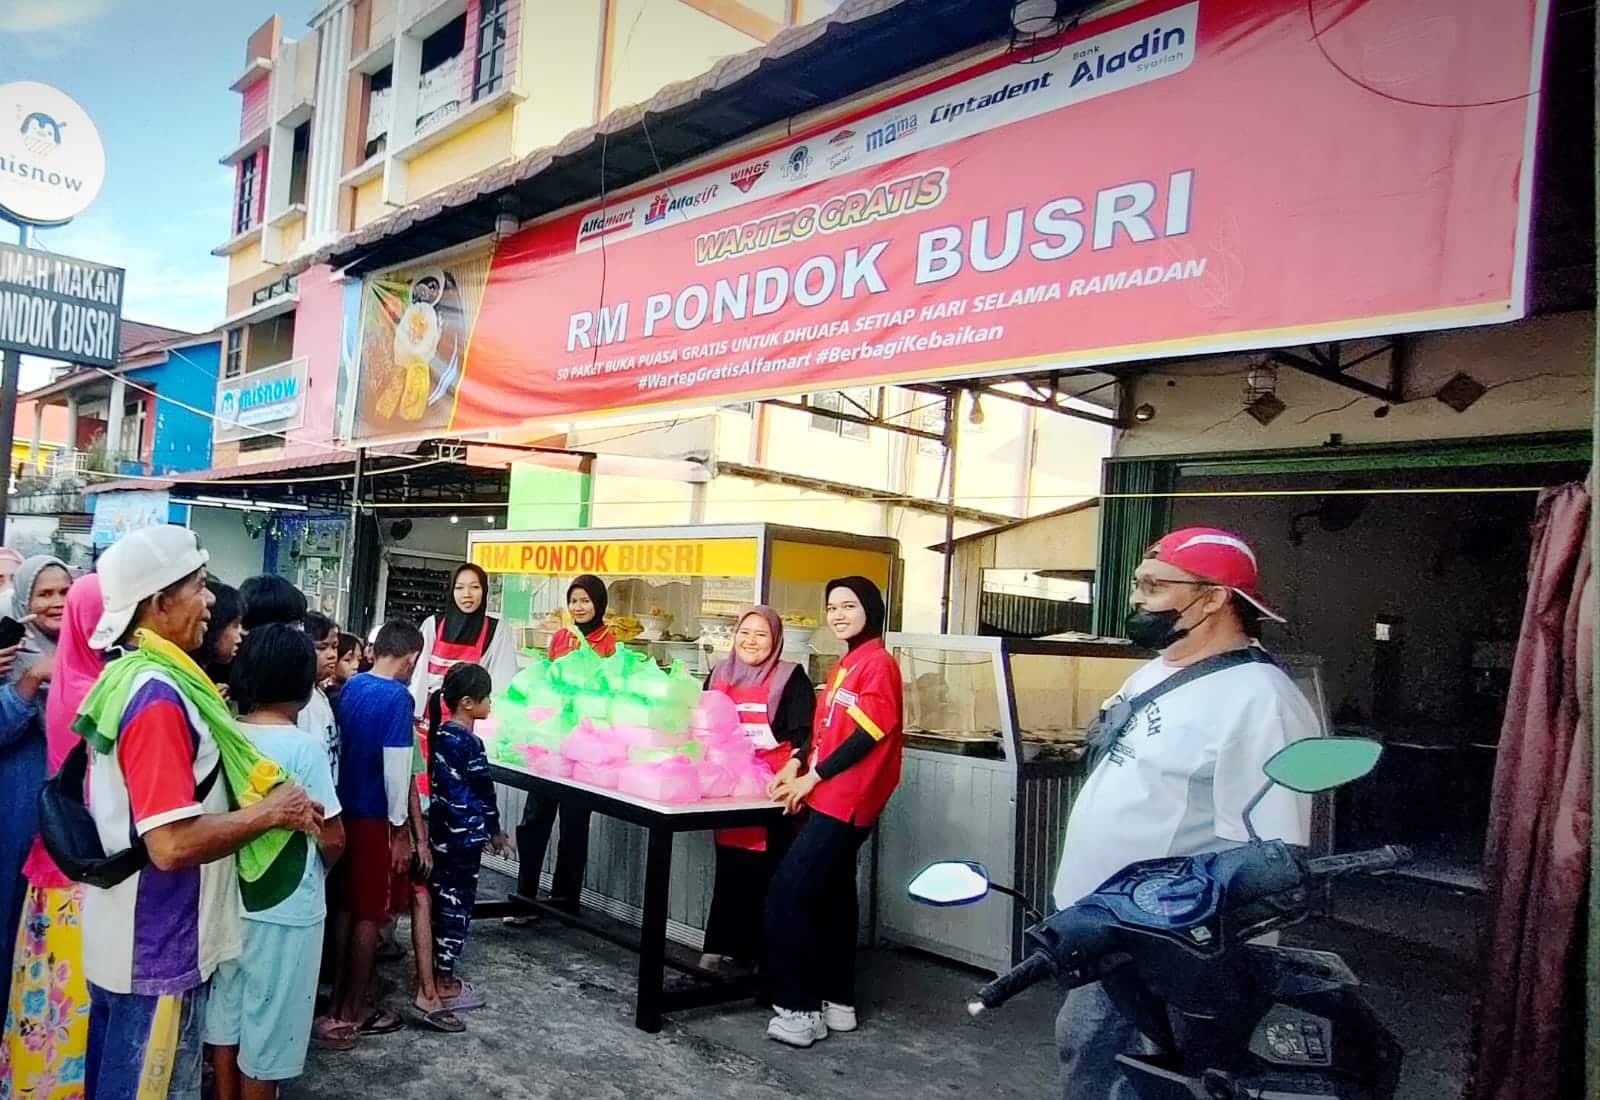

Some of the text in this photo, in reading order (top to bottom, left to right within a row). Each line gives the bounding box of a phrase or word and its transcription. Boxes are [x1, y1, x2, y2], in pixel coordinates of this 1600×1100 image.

[1069, 27, 1186, 89] Aladin
[1072, 45, 1100, 61] Bank
[929, 71, 1054, 126] Ciptadent
[865, 113, 918, 153] mama
[729, 160, 771, 181] WINGS
[580, 207, 636, 234] Alfamart
[667, 184, 719, 213] Alfagift
[696, 169, 947, 263] WARTEG GRATIS
[566, 168, 1195, 351] RM PONDOK BUSRI
[54, 260, 119, 305] MAKAN
[0, 291, 115, 360] NDOK BUSRI
[604, 357, 635, 372] BUKA
[638, 350, 678, 367] PUASA
[681, 341, 727, 360] GRATIS
[730, 332, 779, 352] UNTUK
[782, 320, 850, 344] DHUAFA
[852, 308, 915, 333] SETIAP
[919, 298, 968, 322] HARI
[973, 282, 1062, 312] SELAMA
[1067, 257, 1208, 299] RAMADAN
[637, 324, 1005, 392] #WartegGratisAlfamart #BerbagiKebaikan
[240, 376, 297, 410] misnow
[480, 543, 704, 572] RM. PONDOK BUSRI
